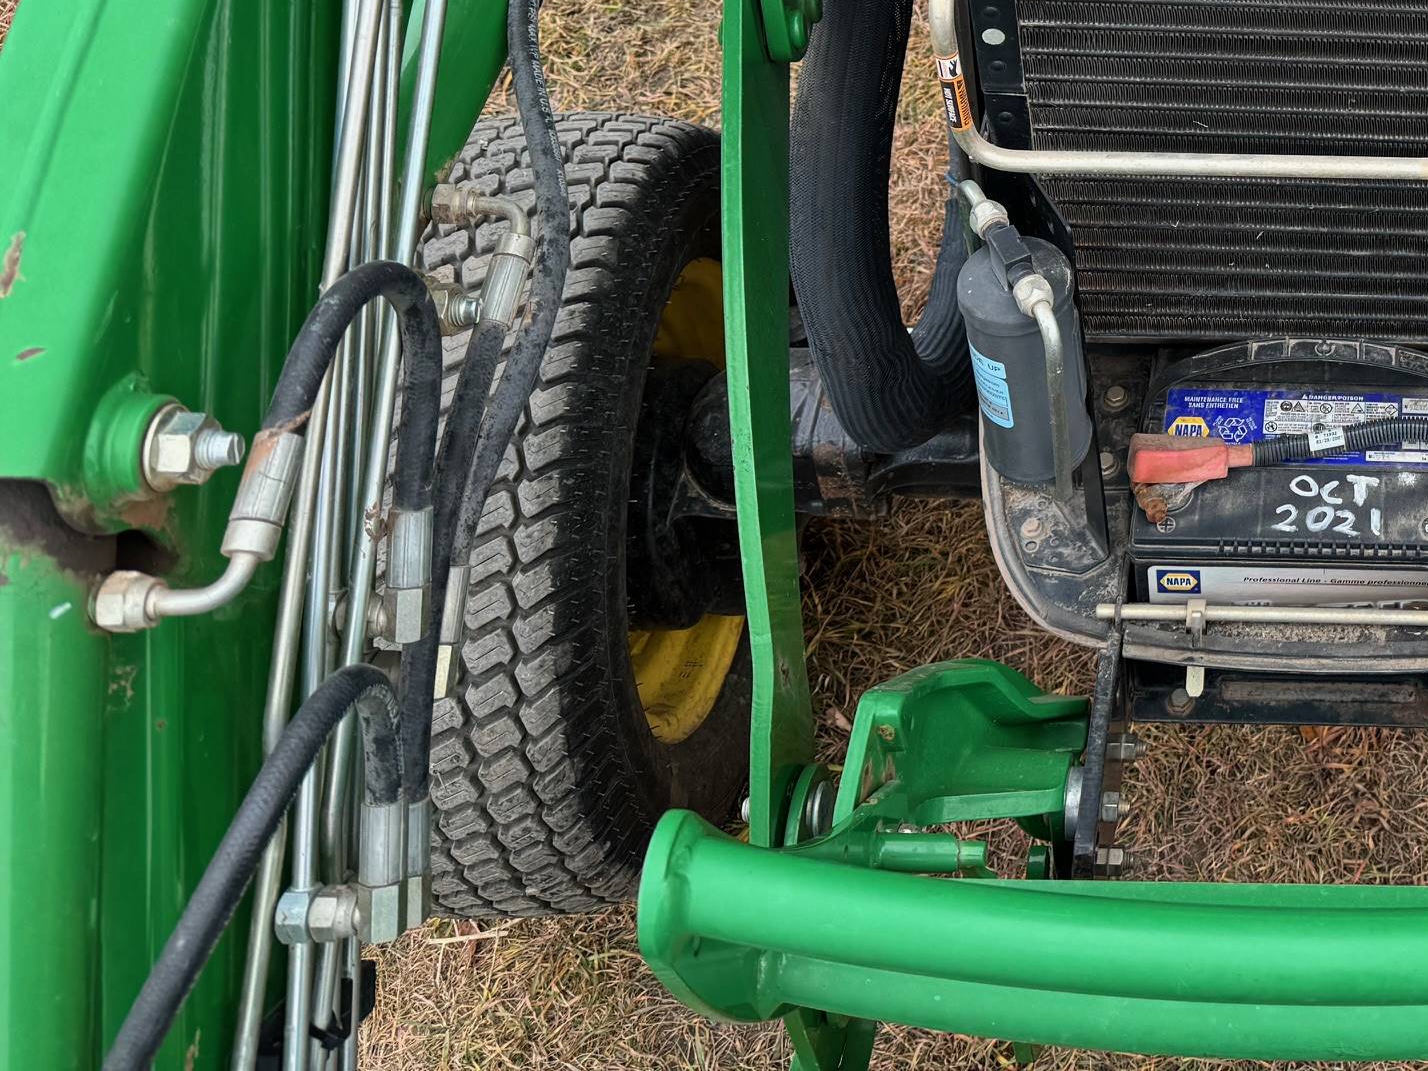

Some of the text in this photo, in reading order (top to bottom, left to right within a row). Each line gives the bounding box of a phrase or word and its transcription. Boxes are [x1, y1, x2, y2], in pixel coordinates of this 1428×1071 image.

[1184, 396, 1227, 404] MAINTENANCE
[1174, 424, 1203, 437] NAPA
[1289, 474, 1380, 507] OCT
[1271, 504, 1382, 537] 2021
[1165, 576, 1192, 587] NAPA
[1243, 576, 1300, 584] Professional
